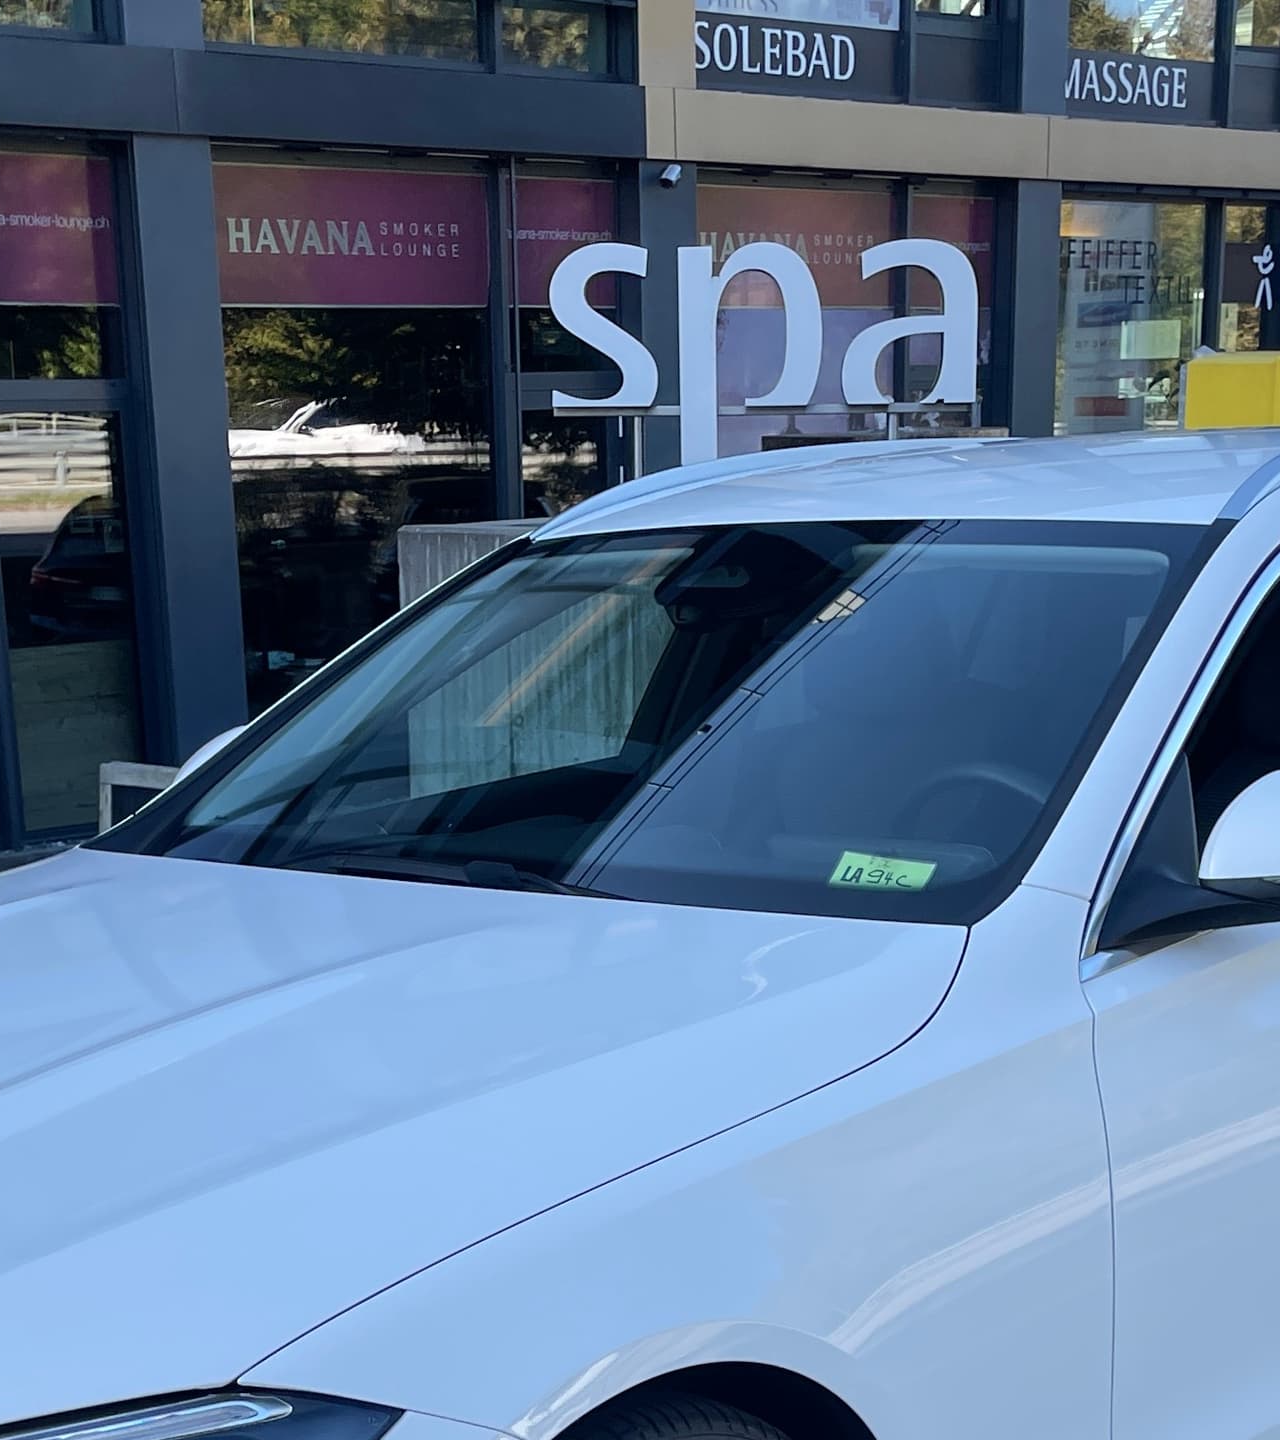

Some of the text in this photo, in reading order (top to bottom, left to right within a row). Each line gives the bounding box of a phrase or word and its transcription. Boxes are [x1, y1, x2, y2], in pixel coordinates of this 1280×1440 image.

[695, 20, 856, 81] SOLEBAD
[1064, 58, 1188, 108] MASSAGE
[227, 217, 460, 256] HAVANA SMOKER
[380, 242, 460, 258] LOUNGE
[813, 234, 874, 247] SMOKER
[549, 239, 979, 466] spa
